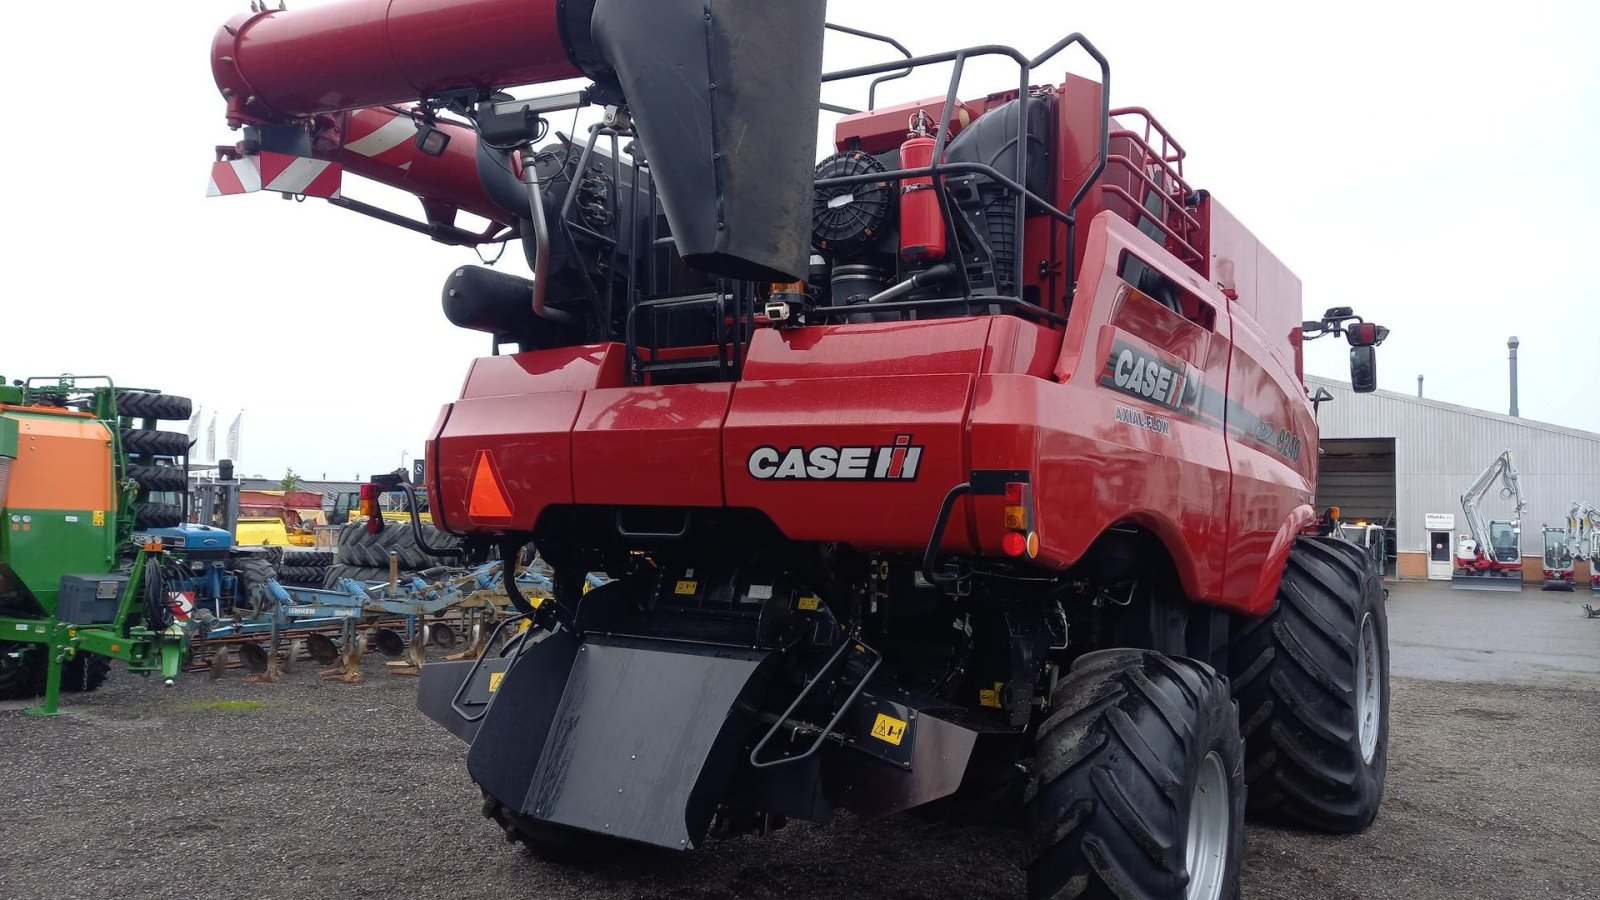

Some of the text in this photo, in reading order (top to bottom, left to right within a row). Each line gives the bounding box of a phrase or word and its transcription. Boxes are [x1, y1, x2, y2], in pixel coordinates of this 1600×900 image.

[1114, 348, 1171, 402] CASE
[1115, 405, 1169, 435] AXIAL-FLOW
[1279, 427, 1300, 462] 9240
[748, 447, 872, 479] CASE
